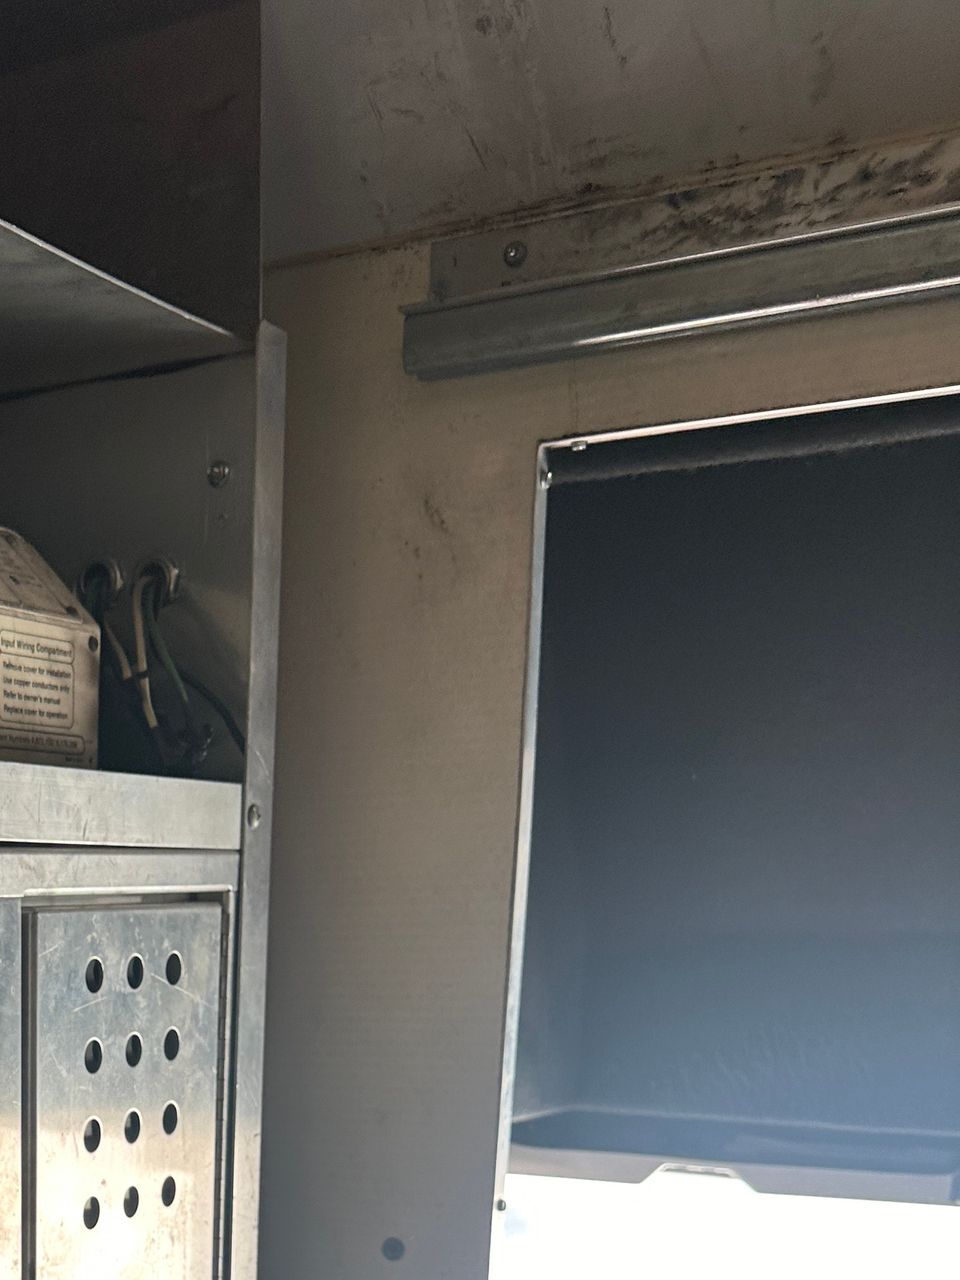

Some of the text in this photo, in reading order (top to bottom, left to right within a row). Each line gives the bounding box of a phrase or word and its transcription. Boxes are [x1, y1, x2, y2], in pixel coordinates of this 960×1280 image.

[0, 636, 72, 658] Input Wiring Compartment
